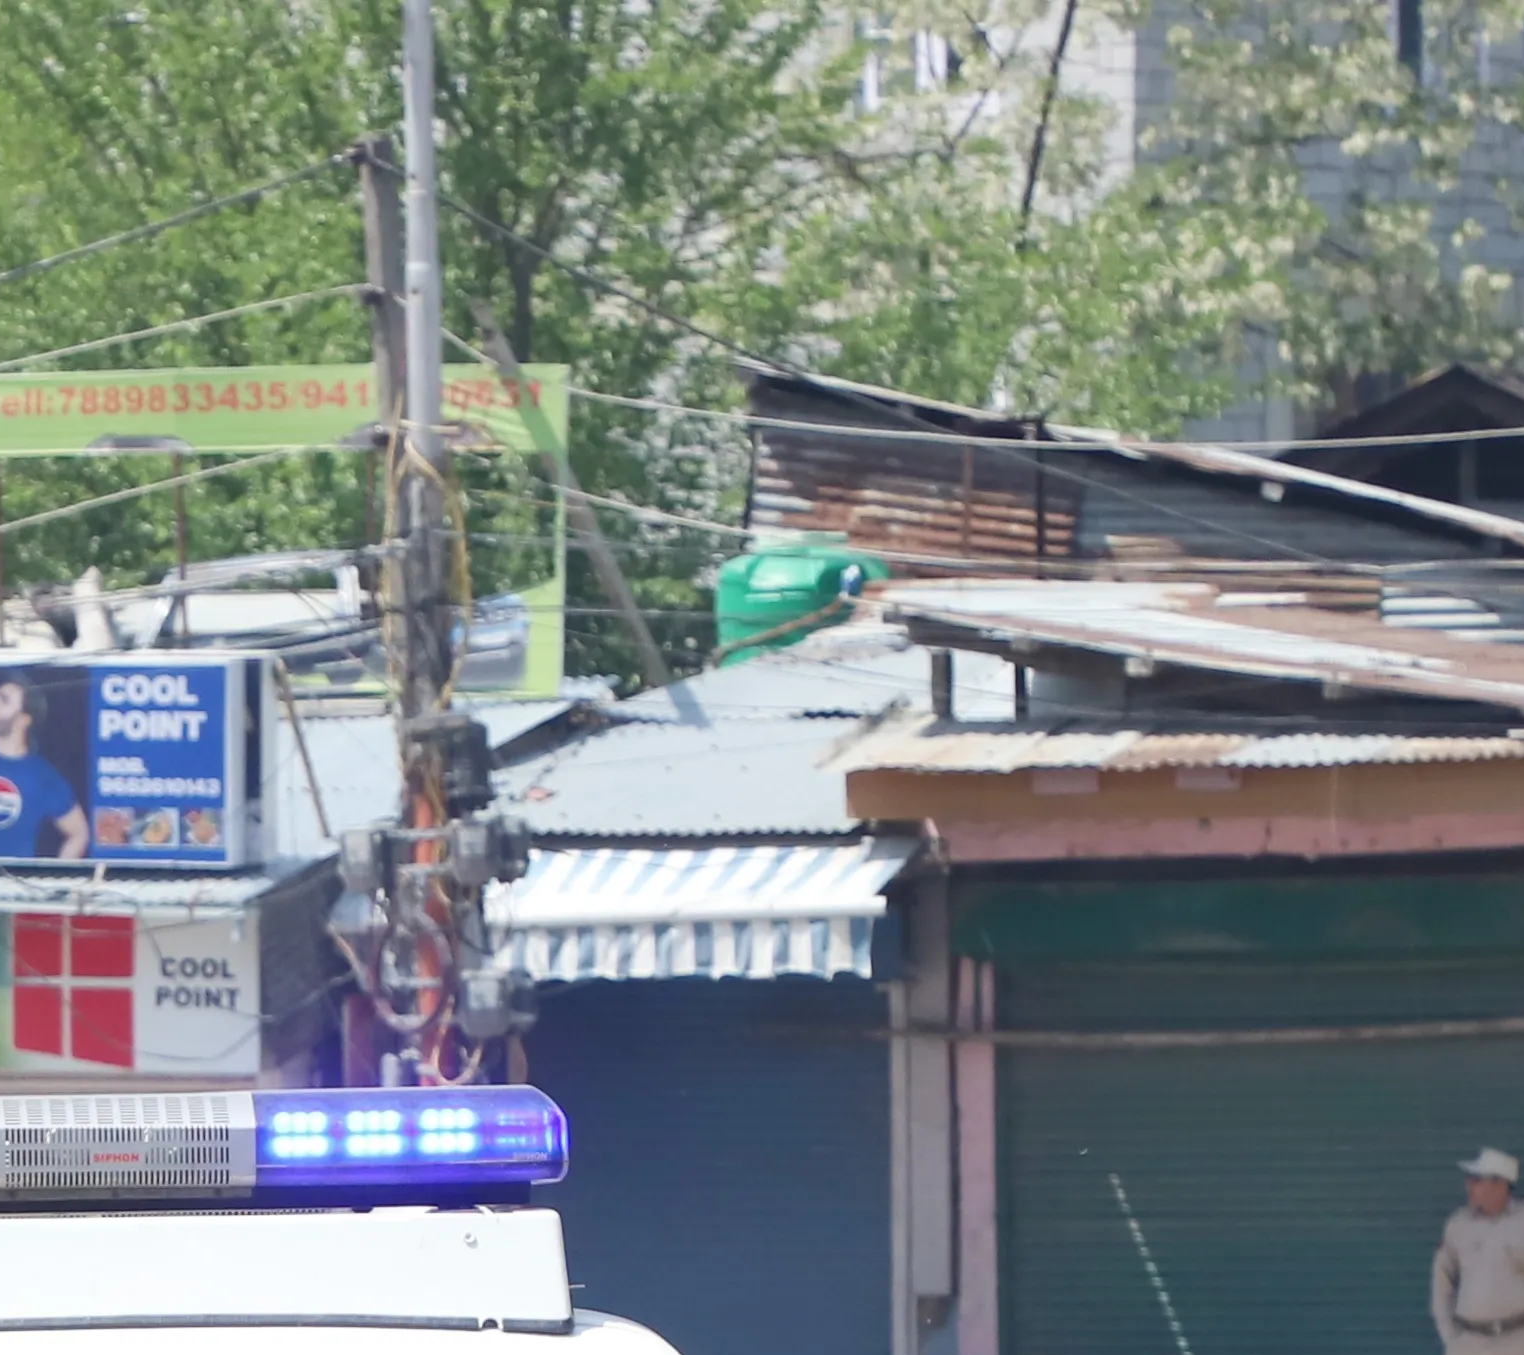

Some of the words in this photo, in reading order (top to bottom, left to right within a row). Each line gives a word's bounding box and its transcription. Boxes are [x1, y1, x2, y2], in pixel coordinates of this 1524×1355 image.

[101, 673, 199, 707] COOL
[98, 708, 209, 741] POINT
[160, 957, 235, 980] COOL
[93, 1153, 140, 1163] SIPHON
